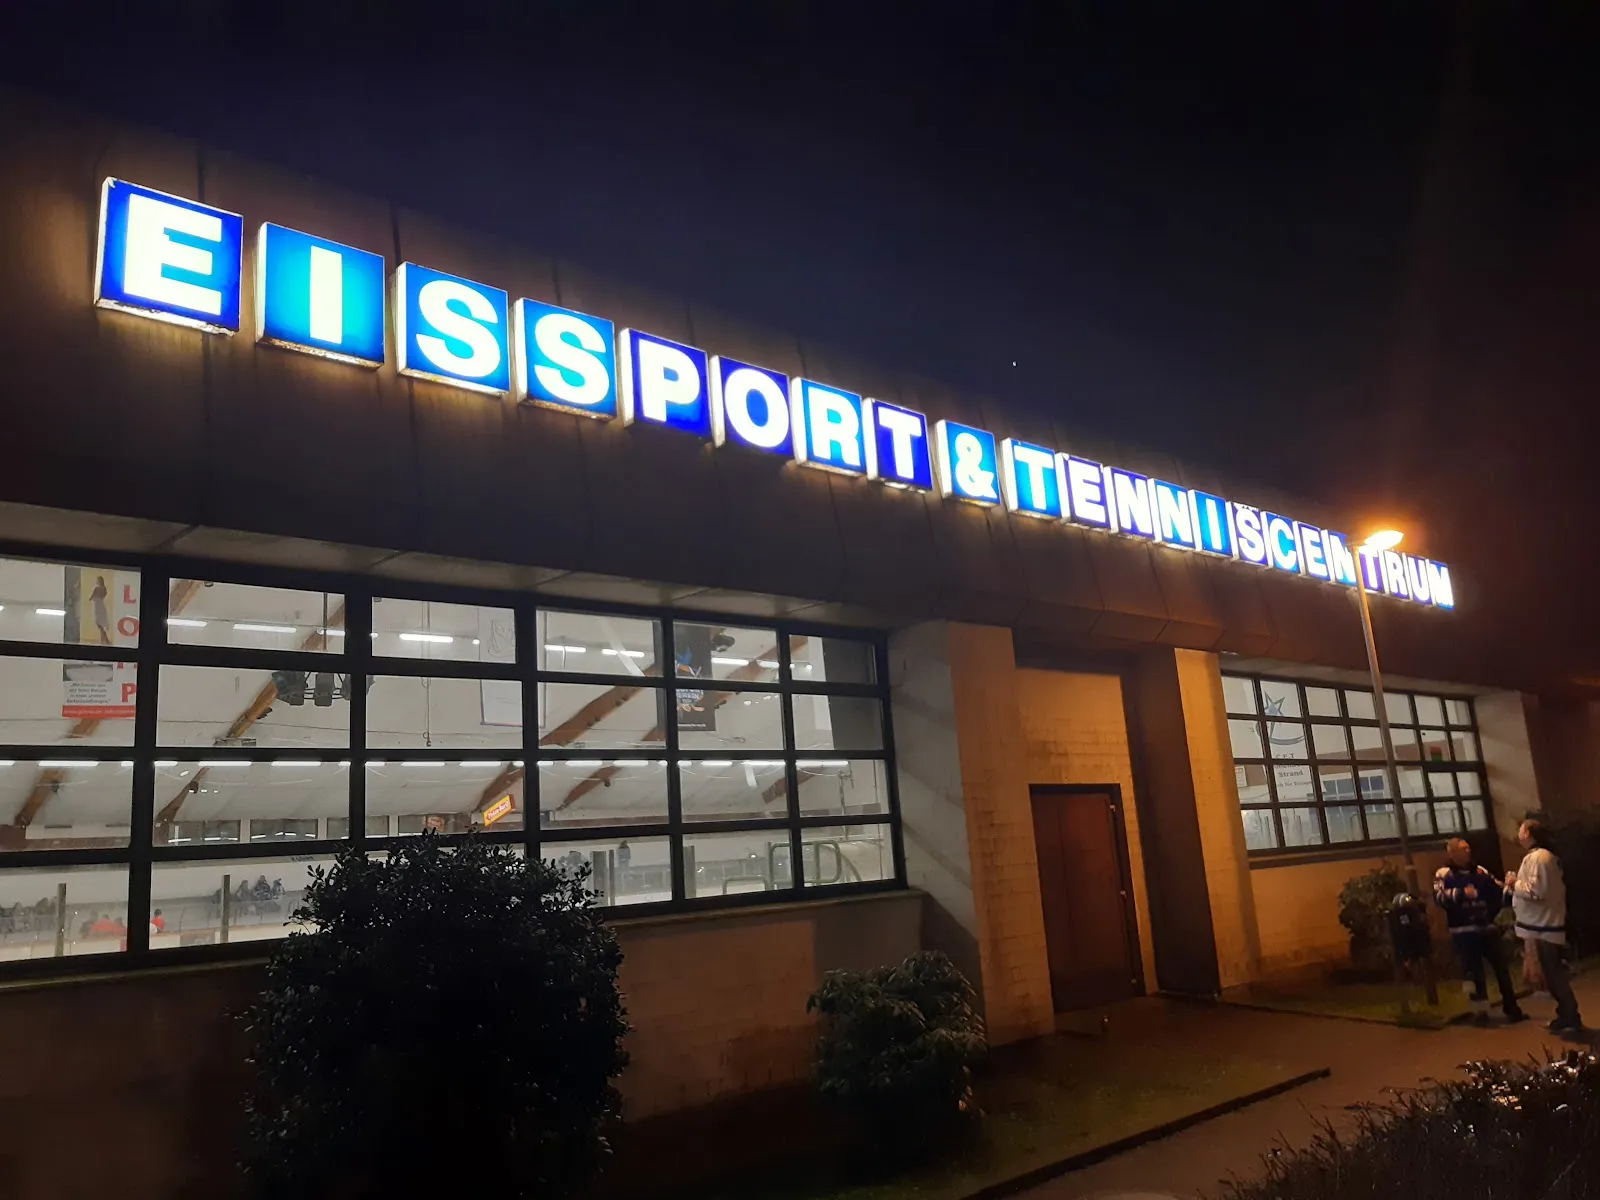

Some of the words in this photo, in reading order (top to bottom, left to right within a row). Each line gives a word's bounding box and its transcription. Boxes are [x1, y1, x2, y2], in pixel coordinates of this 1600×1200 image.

[124, 193, 922, 479] EISSPORT
[955, 432, 998, 499] &
[1278, 770, 1304, 778] Strand
